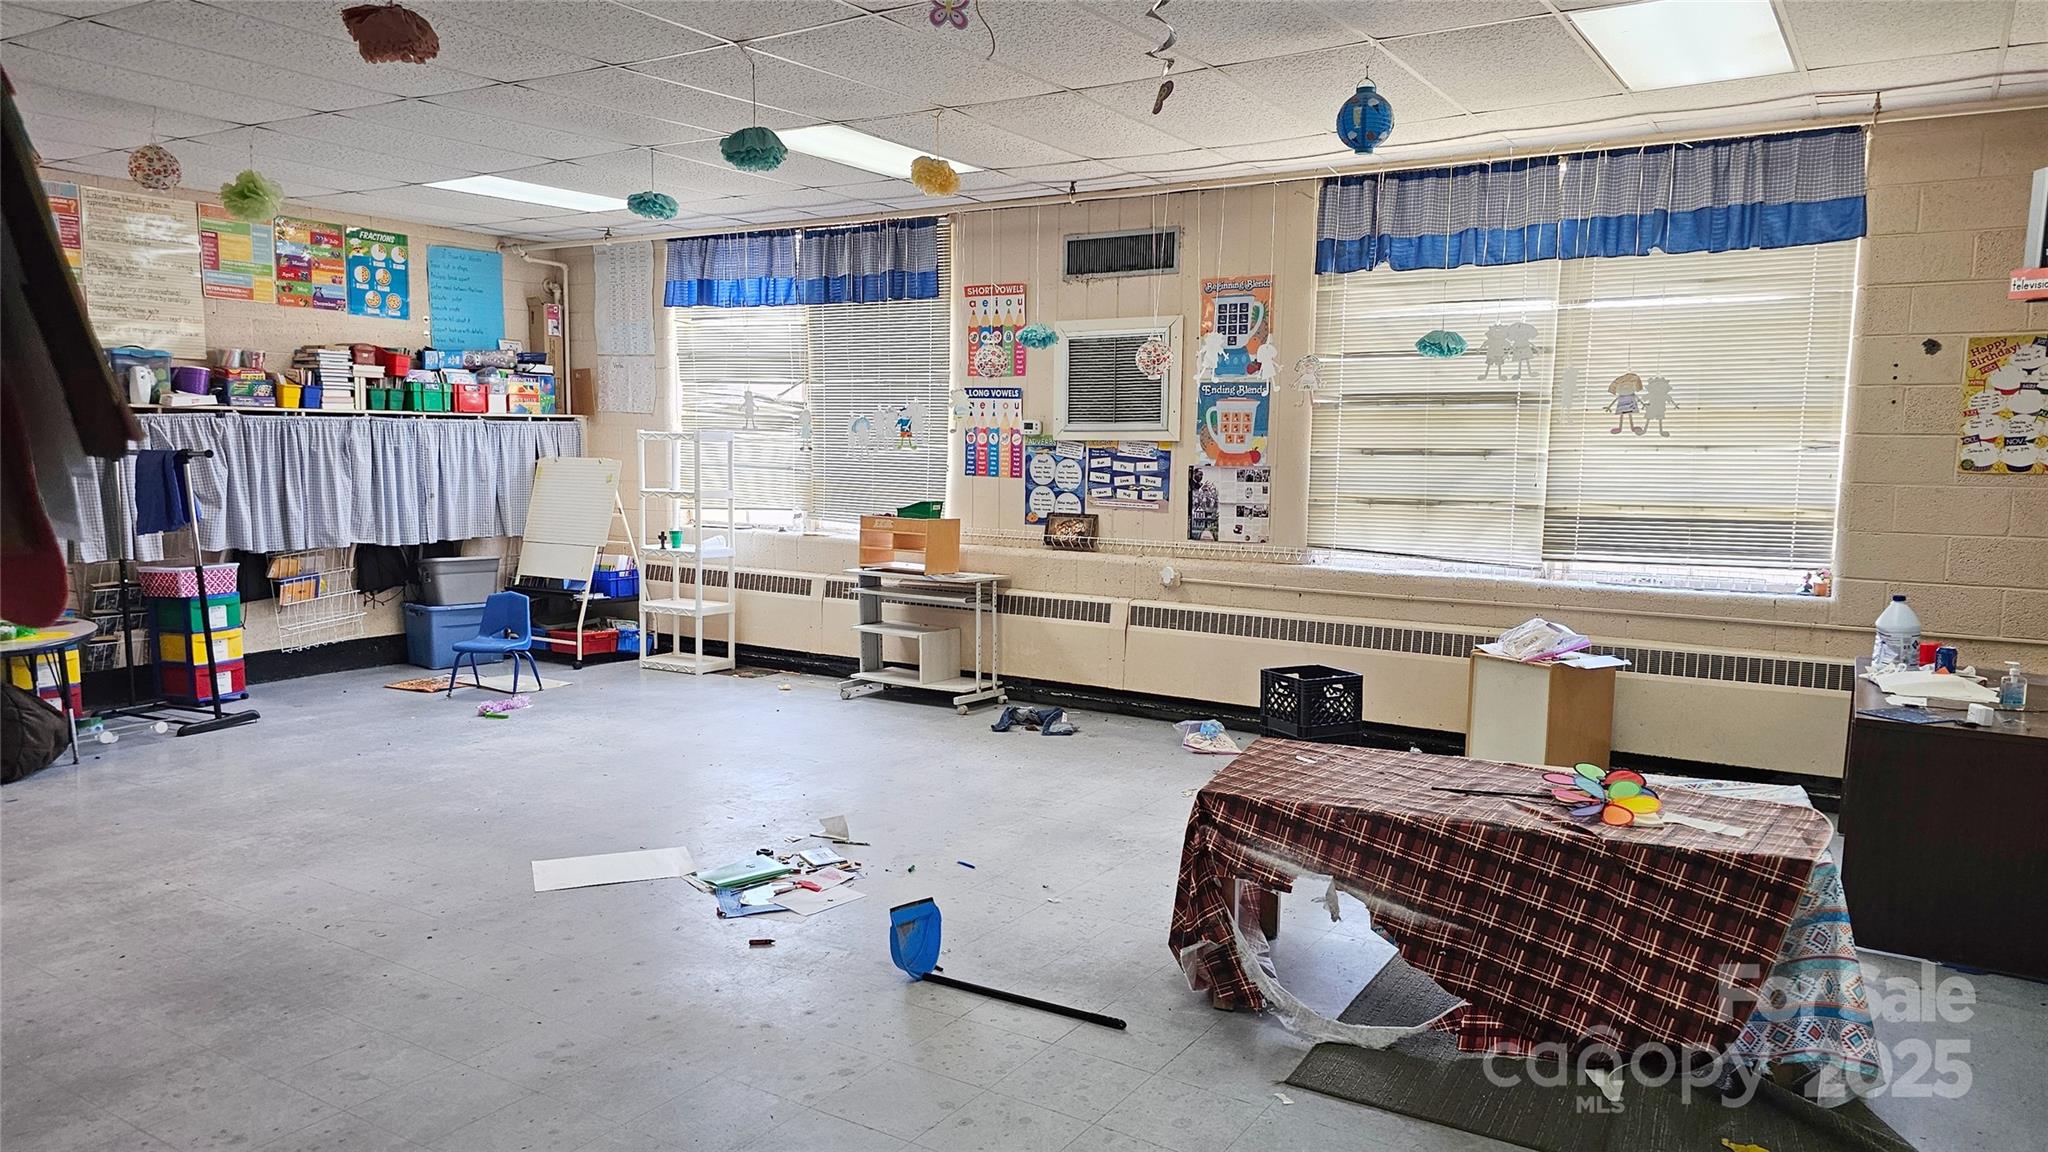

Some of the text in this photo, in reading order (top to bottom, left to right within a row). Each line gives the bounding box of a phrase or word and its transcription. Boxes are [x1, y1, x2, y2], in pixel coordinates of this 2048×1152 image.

[359, 231, 395, 243] FRACTIONS
[967, 285, 1024, 295] SHORT VOWELS
[1204, 280, 1272, 293] Beginning Blends
[982, 299, 988, 307] e
[1017, 298, 1023, 306] u
[1970, 338, 2007, 356] Happy
[1969, 342, 2021, 368] Birthday!
[968, 389, 1019, 397] LONG VOWELS
[1202, 385, 1267, 396] Ending Blends
[979, 401, 986, 409] e
